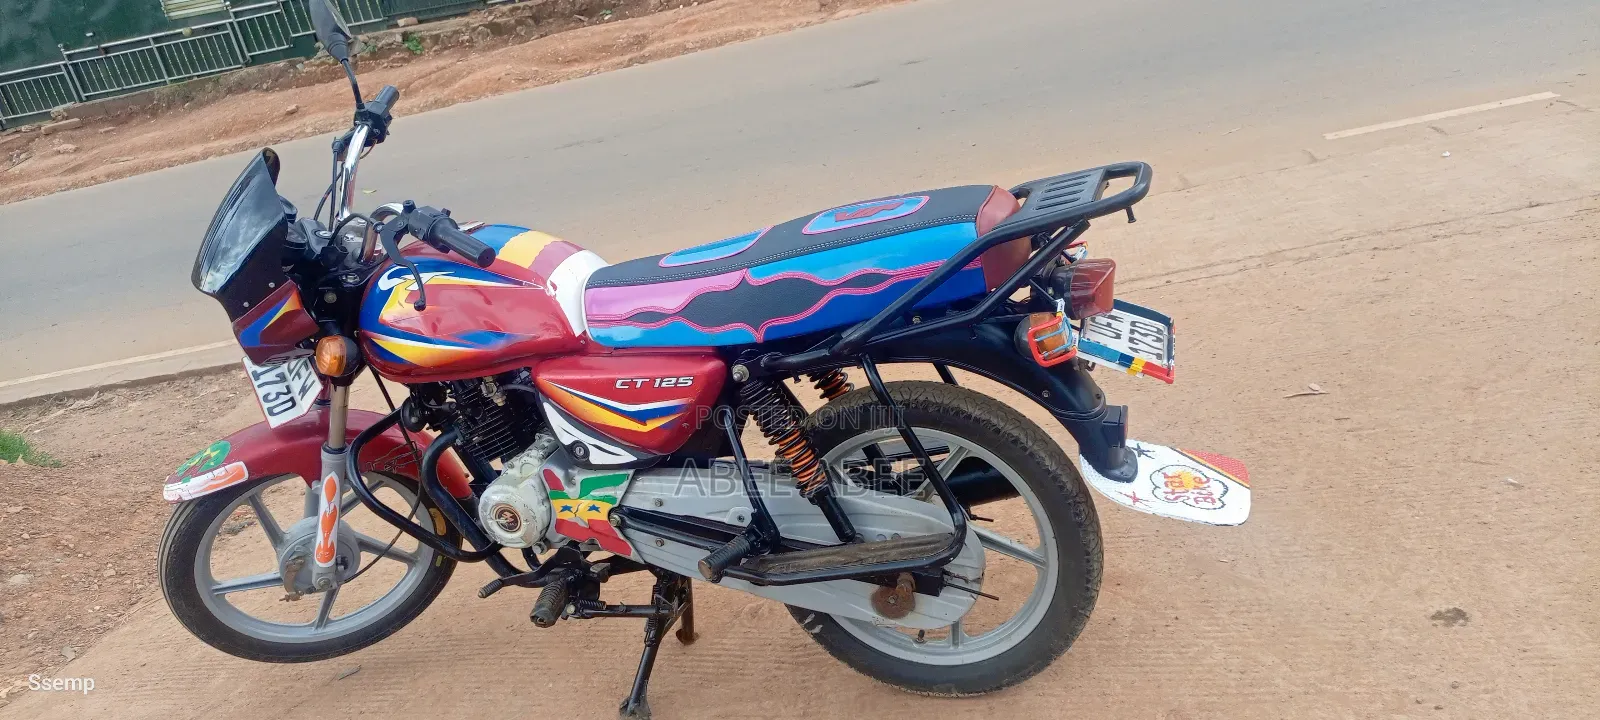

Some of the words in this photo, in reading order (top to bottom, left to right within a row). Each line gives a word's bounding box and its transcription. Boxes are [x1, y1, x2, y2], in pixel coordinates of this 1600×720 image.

[1128, 321, 1164, 360] 1730
[251, 364, 297, 417] 1730
[615, 378, 650, 389] CT
[653, 376, 694, 388] 125
